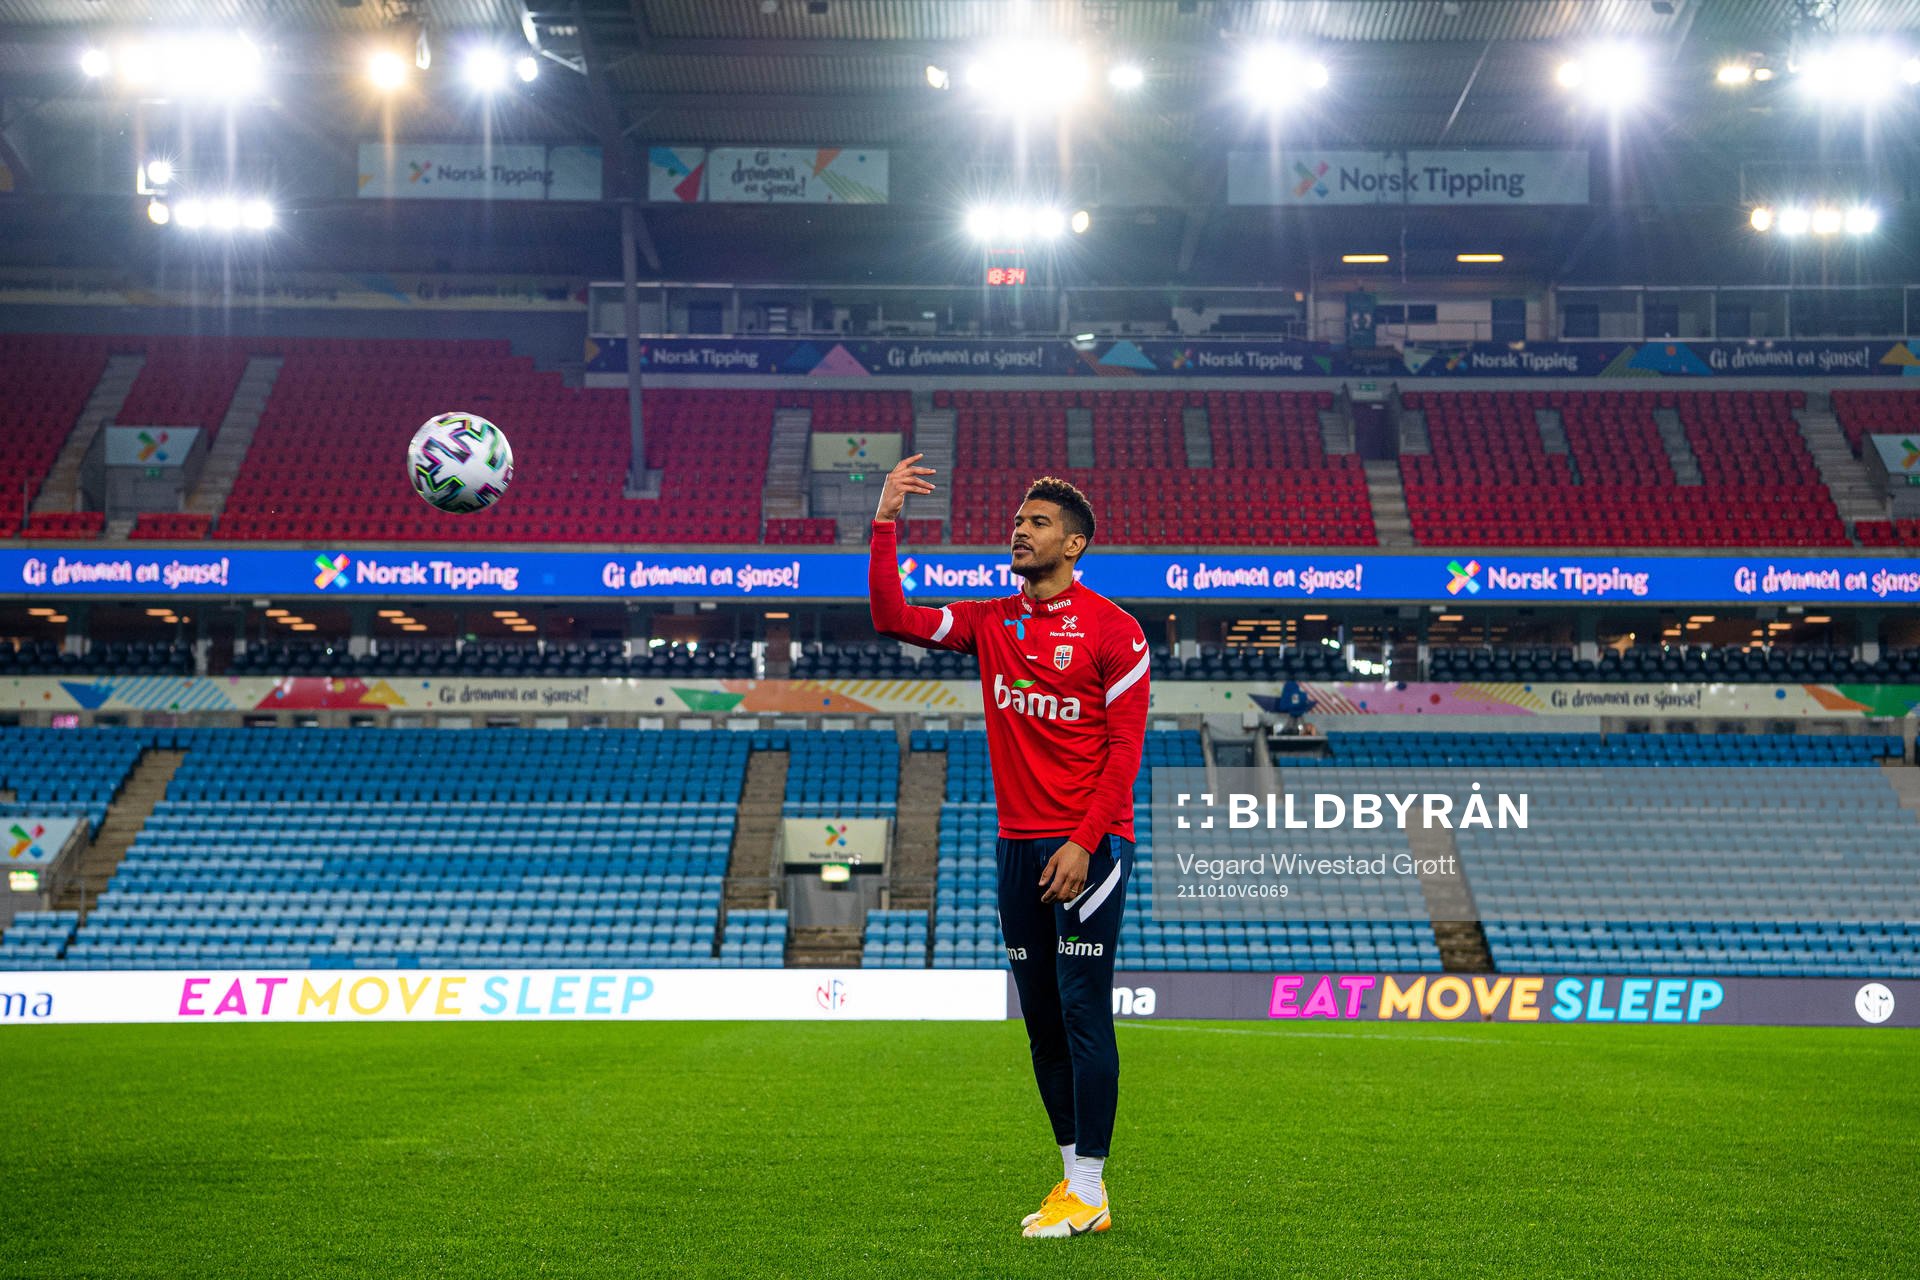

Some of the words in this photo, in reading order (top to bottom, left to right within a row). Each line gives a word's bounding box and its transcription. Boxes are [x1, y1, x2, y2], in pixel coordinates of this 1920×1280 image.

[437, 164, 487, 182] Norsk
[492, 165, 554, 186] Tipping
[1339, 167, 1418, 192] Norsk
[1423, 167, 1525, 198] Tipping
[653, 348, 698, 365] Norsk
[702, 349, 759, 368] Tipping
[887, 348, 905, 367] Gi
[1199, 352, 1244, 368] Norsk
[1246, 353, 1303, 371] Tipping
[1472, 352, 1518, 368] Norsk
[1521, 353, 1578, 371] Tipping
[1709, 349, 1727, 369] Gi
[1796, 353, 1815, 366] en
[1818, 346, 1870, 370] sjanse!
[22, 558, 47, 586] Gi
[135, 562, 160, 583] en
[163, 557, 229, 589] sjanse!
[356, 560, 427, 584] Norsk
[429, 561, 519, 590] Tipping
[602, 562, 625, 589] Gi
[629, 561, 707, 589] drømmen
[710, 566, 733, 586] en
[736, 561, 800, 592] sjanse!
[924, 563, 994, 587] Norsk
[1166, 563, 1188, 591] Gi
[1193, 563, 1269, 590] drømmen
[1273, 568, 1295, 588] en
[1299, 563, 1362, 594] sjanse!
[1488, 567, 1558, 590] Norsk
[1559, 567, 1649, 596] Tipping
[1734, 566, 1757, 594] Gi
[1762, 564, 1840, 594] drømmen
[1844, 570, 1867, 591] en
[1871, 567, 1920, 598] sjans
[1047, 599, 1072, 612] bama
[439, 684, 456, 704] Gi
[993, 673, 1081, 721] bama
[1551, 689, 1567, 708] Gi
[1634, 693, 1650, 705] en
[1653, 689, 1701, 710] sjanse!
[1058, 935, 1104, 957] bama
[178, 977, 288, 1016] EAT
[297, 975, 467, 1016] MOVE
[479, 975, 655, 1016] SLEEP
[1268, 975, 1376, 1019] EAT
[1378, 975, 1544, 1021] MOVE
[1551, 977, 1724, 1023] SLEEP
